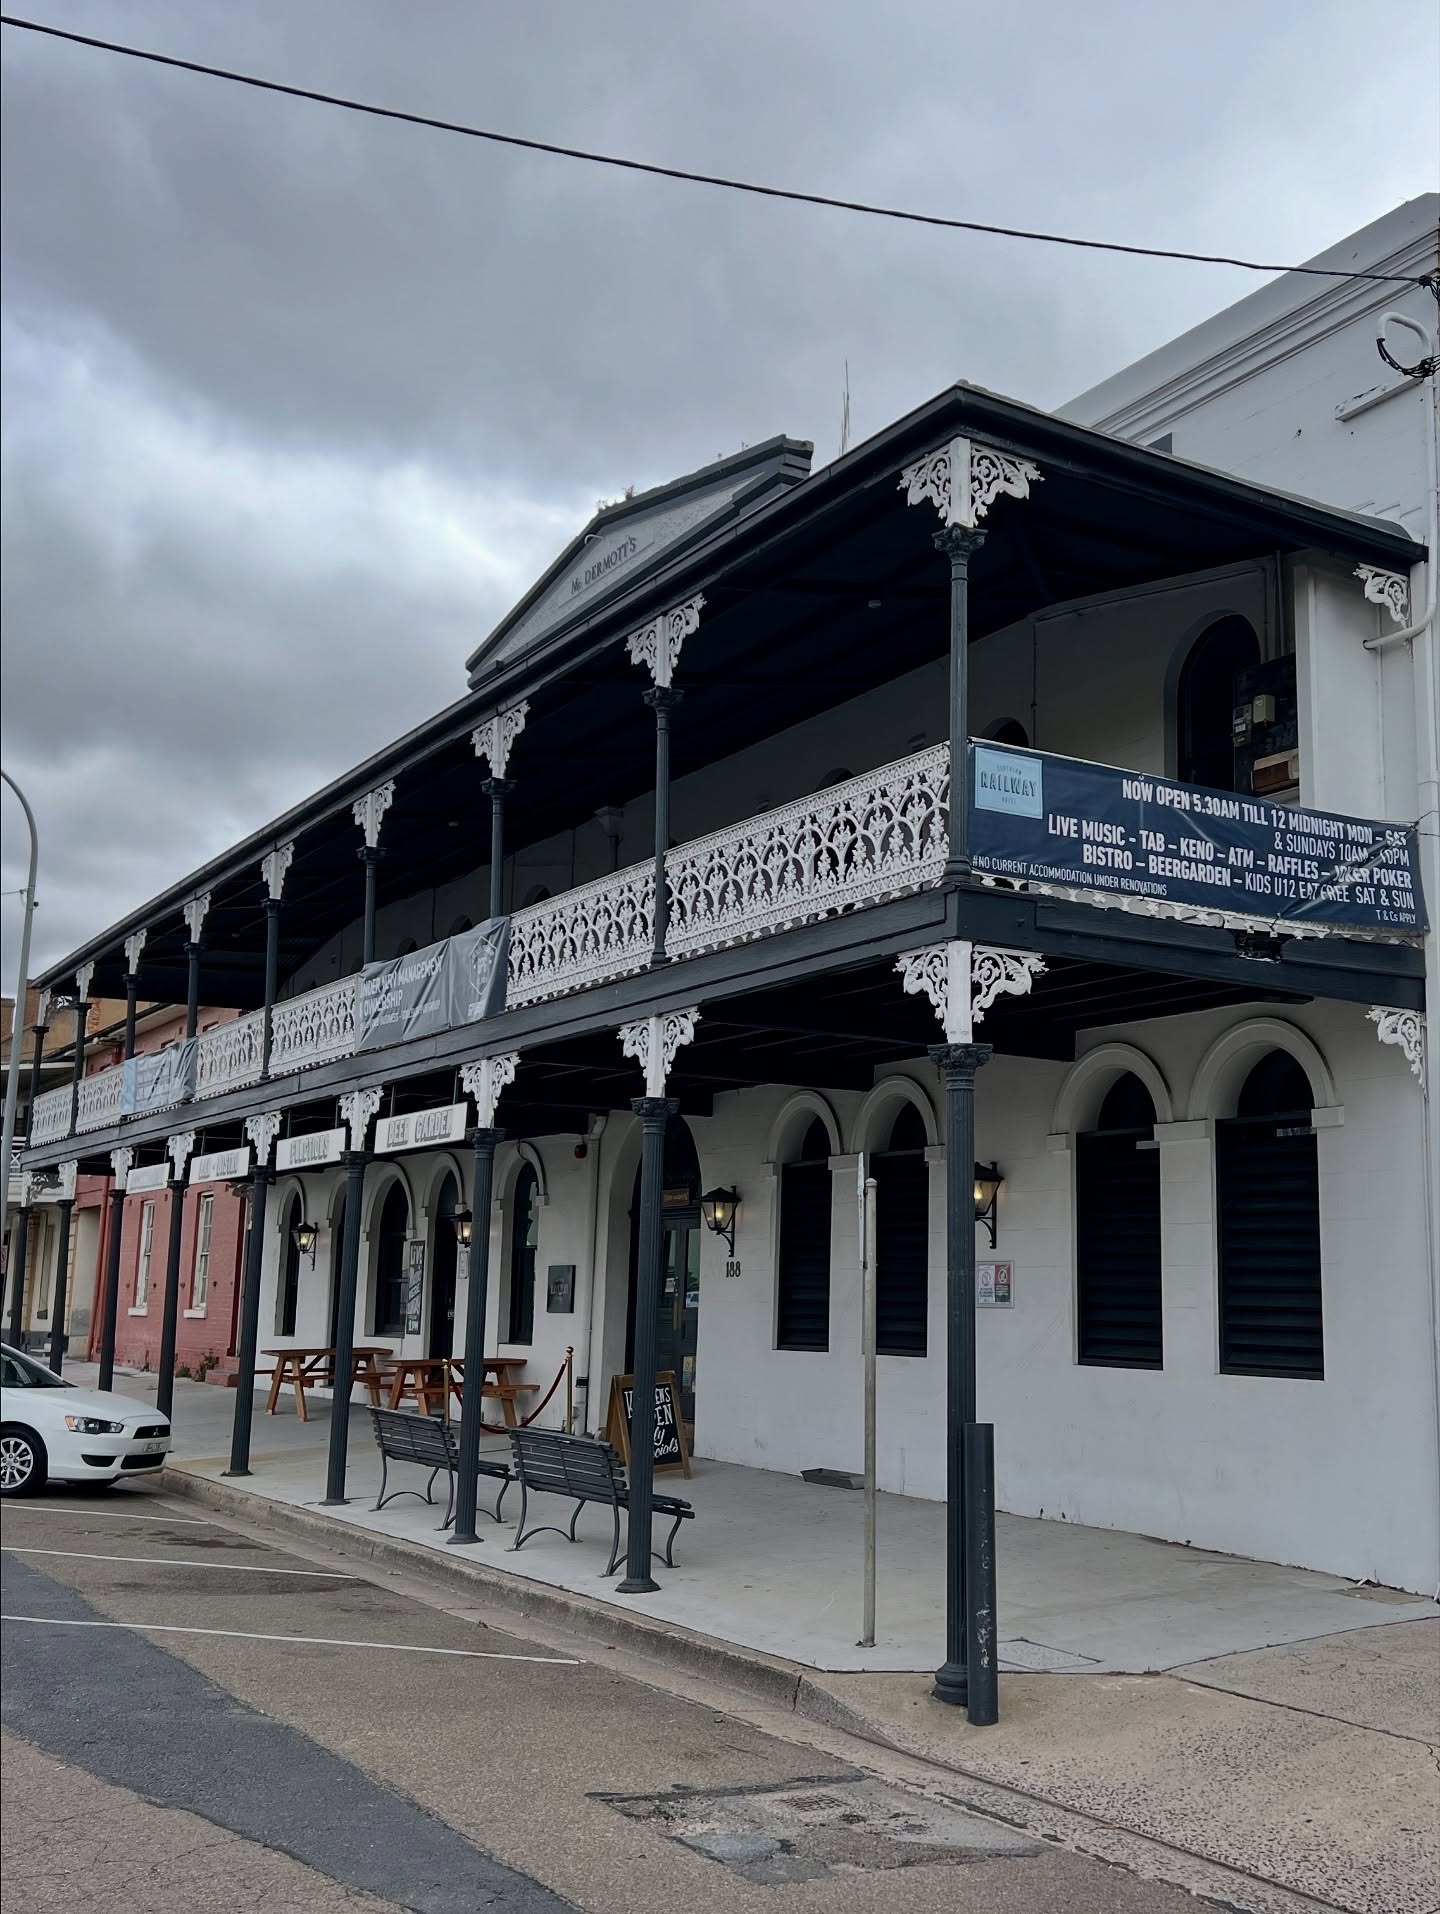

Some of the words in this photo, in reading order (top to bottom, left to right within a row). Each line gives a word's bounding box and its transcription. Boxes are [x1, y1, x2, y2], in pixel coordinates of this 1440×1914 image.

[585, 536, 636, 584] DERMOTT'S
[980, 771, 1037, 797] RAILWAY
[1122, 779, 1153, 803] NOW
[1156, 785, 1190, 811] OPEN
[1192, 794, 1240, 820] 5.30AM
[1241, 803, 1268, 826] TILL
[1271, 809, 1286, 829] 12
[1288, 813, 1345, 840] MIDNIGHT
[1346, 823, 1373, 844] MON
[1048, 814, 1078, 838] LIVE
[1081, 819, 1126, 846] MUSIC
[1139, 830, 1165, 852] TAB
[1180, 837, 1214, 861] KENO
[1228, 847, 1254, 869] ATM
[1267, 853, 1319, 880] RAFFLES
[1373, 867, 1412, 889] POKER
[1274, 831, 1283, 850] &
[1286, 833, 1336, 860] SUNDAYS
[1339, 843, 1369, 863] 10AM
[972, 855, 989, 869] #NO
[992, 857, 1027, 875] CURRENT
[1029, 863, 1092, 884] ACCOMMODATION
[1094, 873, 1119, 888] UNDER
[1120, 877, 1167, 896] RENOVATIONS
[1083, 844, 1133, 870] BISTRO
[1148, 855, 1231, 887] BEERGARDEN
[1245, 871, 1271, 894] KIDS
[1274, 878, 1297, 898] U12
[1299, 881, 1320, 901] EAT
[1320, 884, 1350, 903] FREE
[1355, 886, 1376, 905] SAT
[1380, 889, 1390, 907] &
[1392, 891, 1415, 910] SUN
[1375, 909, 1381, 921] T
[1383, 910, 1389, 921] &
[1399, 912, 1416, 924] APPLY
[398, 953, 444, 986] MANAGEMENT
[387, 1117, 410, 1148] BEER
[414, 1108, 454, 1143] GARDEN
[726, 1261, 741, 1278] 188
